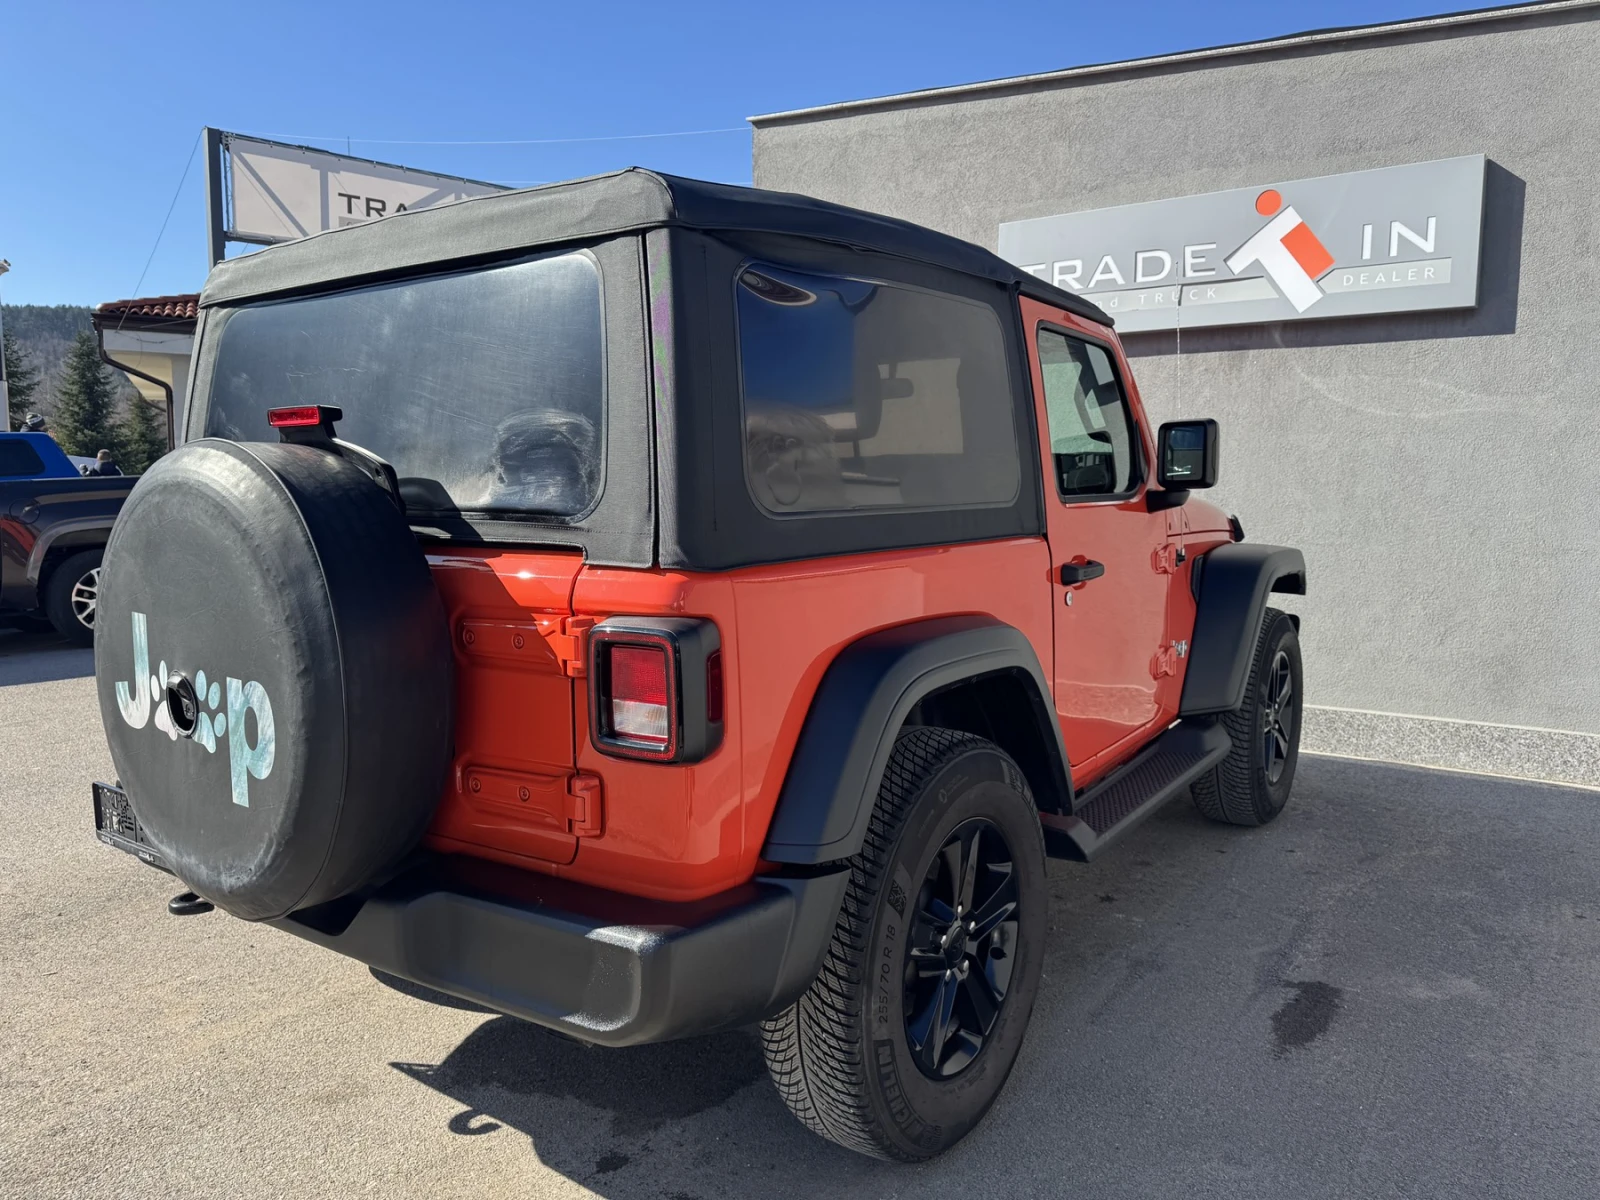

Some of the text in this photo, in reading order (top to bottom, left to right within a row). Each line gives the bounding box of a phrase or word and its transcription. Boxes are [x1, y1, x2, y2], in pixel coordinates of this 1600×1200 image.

[1361, 215, 1436, 260] IN
[1138, 287, 1217, 304] TRUCK
[1343, 267, 1435, 286] DEALER
[879, 924, 896, 1023] 255/70 R 18
